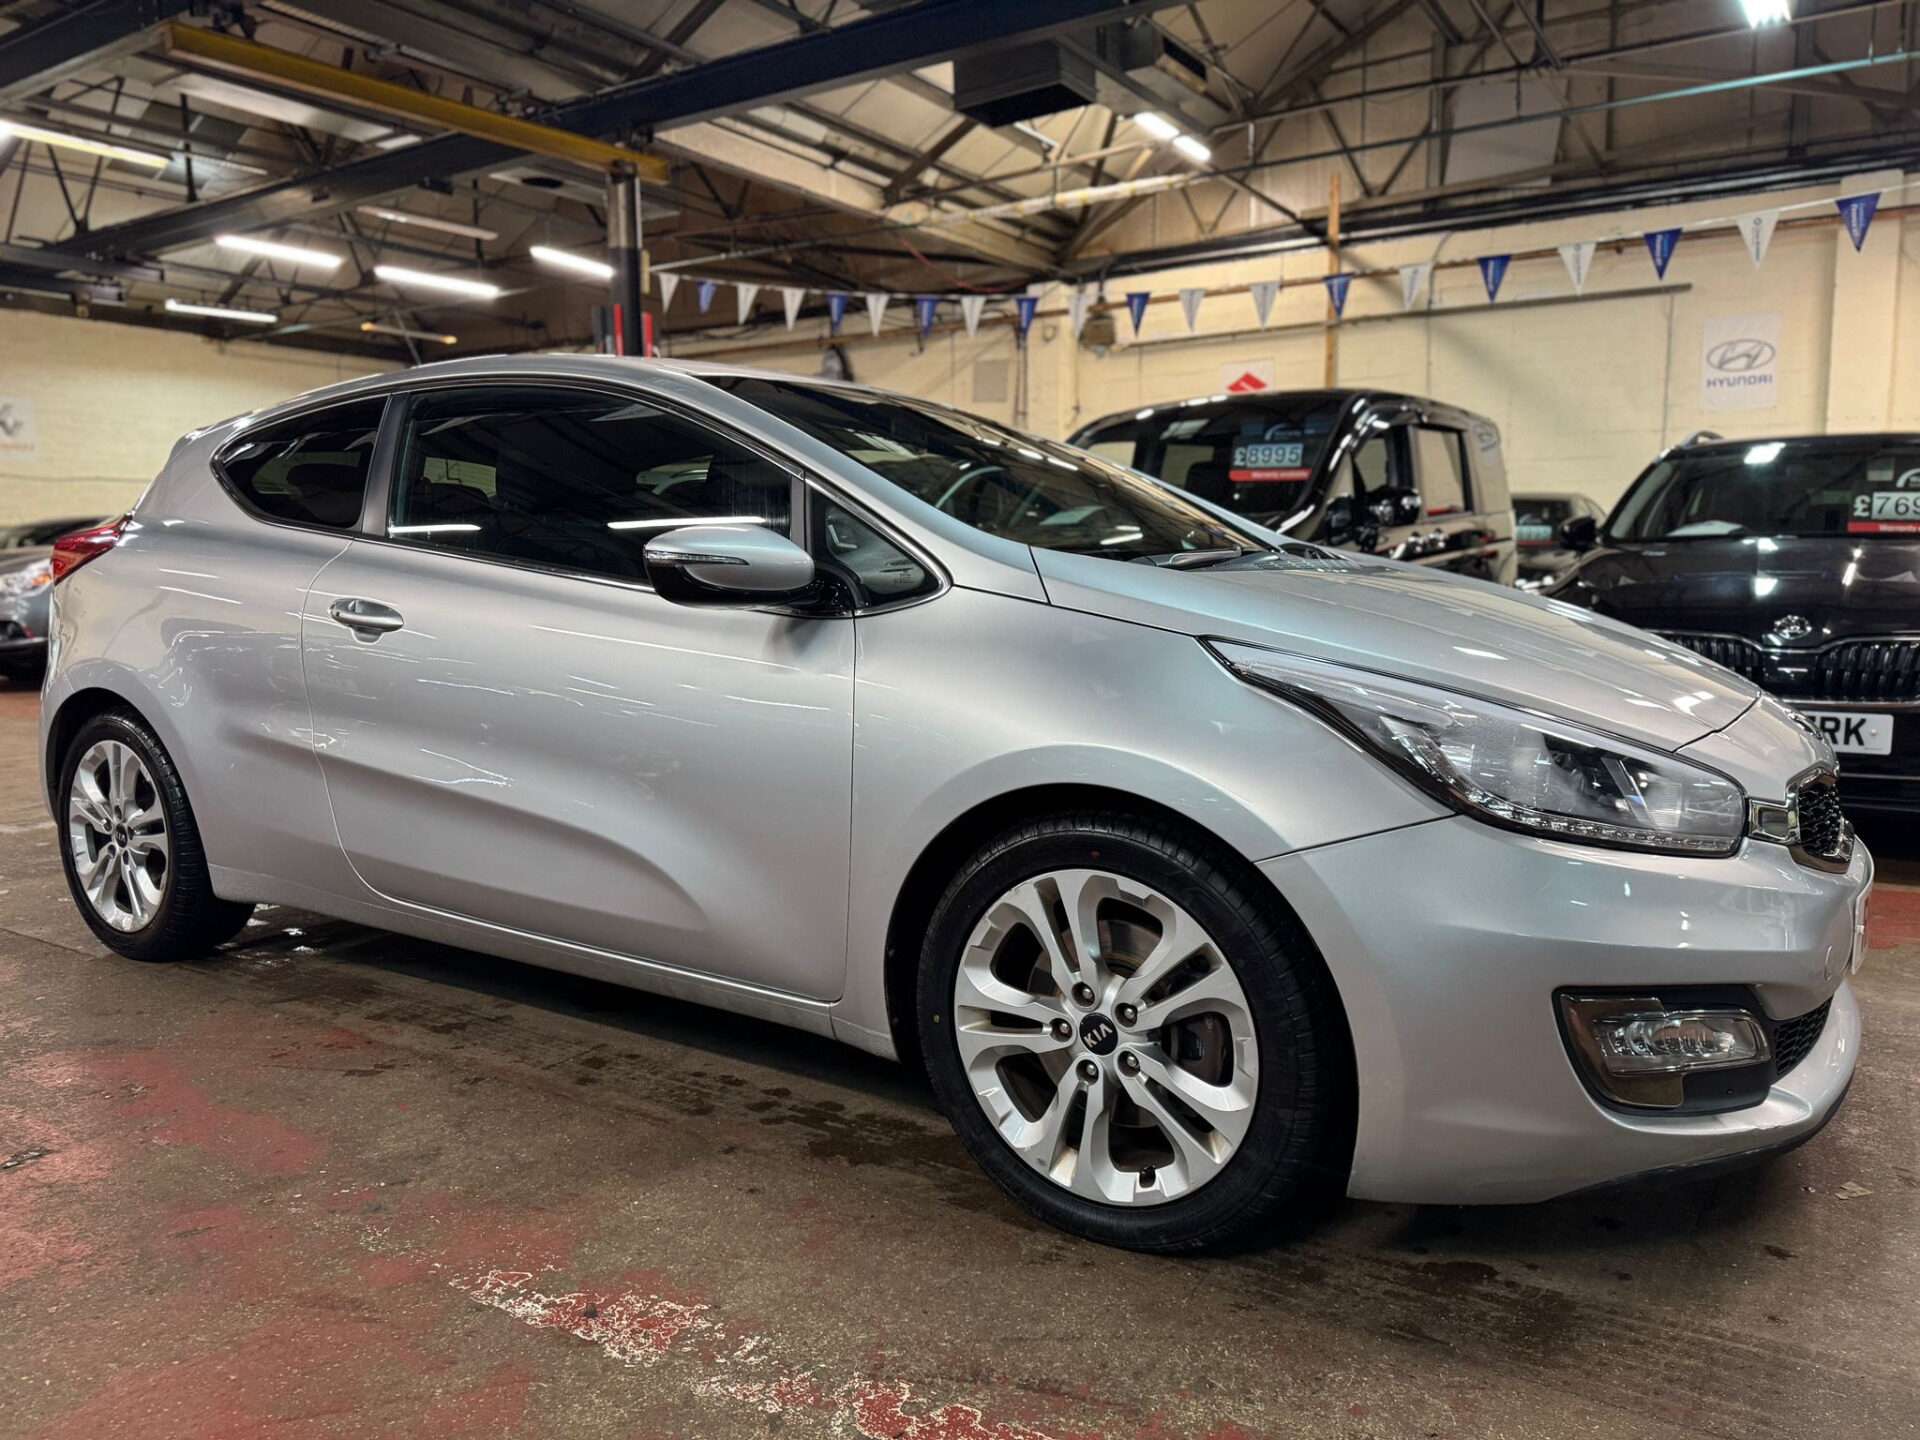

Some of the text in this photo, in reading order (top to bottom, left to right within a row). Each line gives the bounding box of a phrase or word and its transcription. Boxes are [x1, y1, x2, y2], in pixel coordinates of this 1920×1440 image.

[1706, 374, 1773, 388] HYUNDAI
[1232, 445, 1301, 466] £8995
[1806, 715, 1867, 746] RK
[1083, 1023, 1113, 1048] KIA
